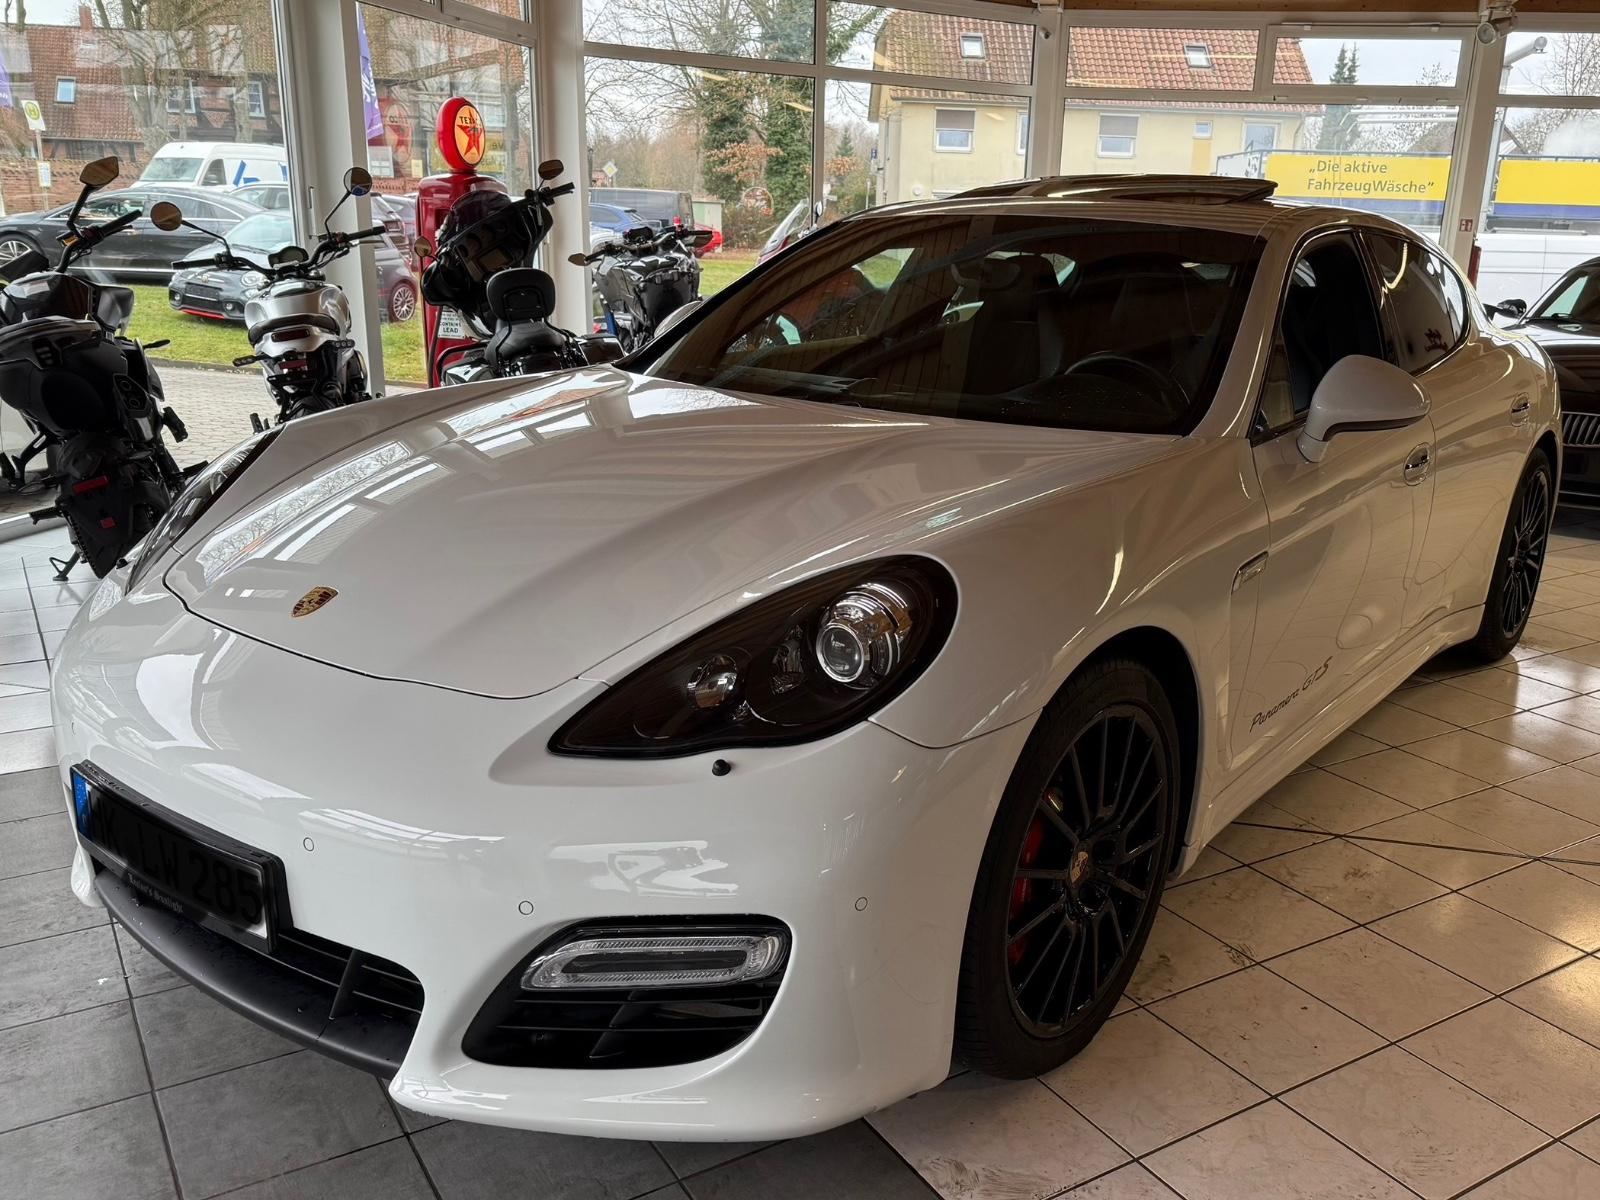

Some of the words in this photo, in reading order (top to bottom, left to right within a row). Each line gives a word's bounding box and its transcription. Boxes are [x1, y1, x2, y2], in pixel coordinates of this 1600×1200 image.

[1343, 160, 1388, 175] aktive
[1302, 656, 1333, 691] GTS
[189, 850, 263, 925] 285
